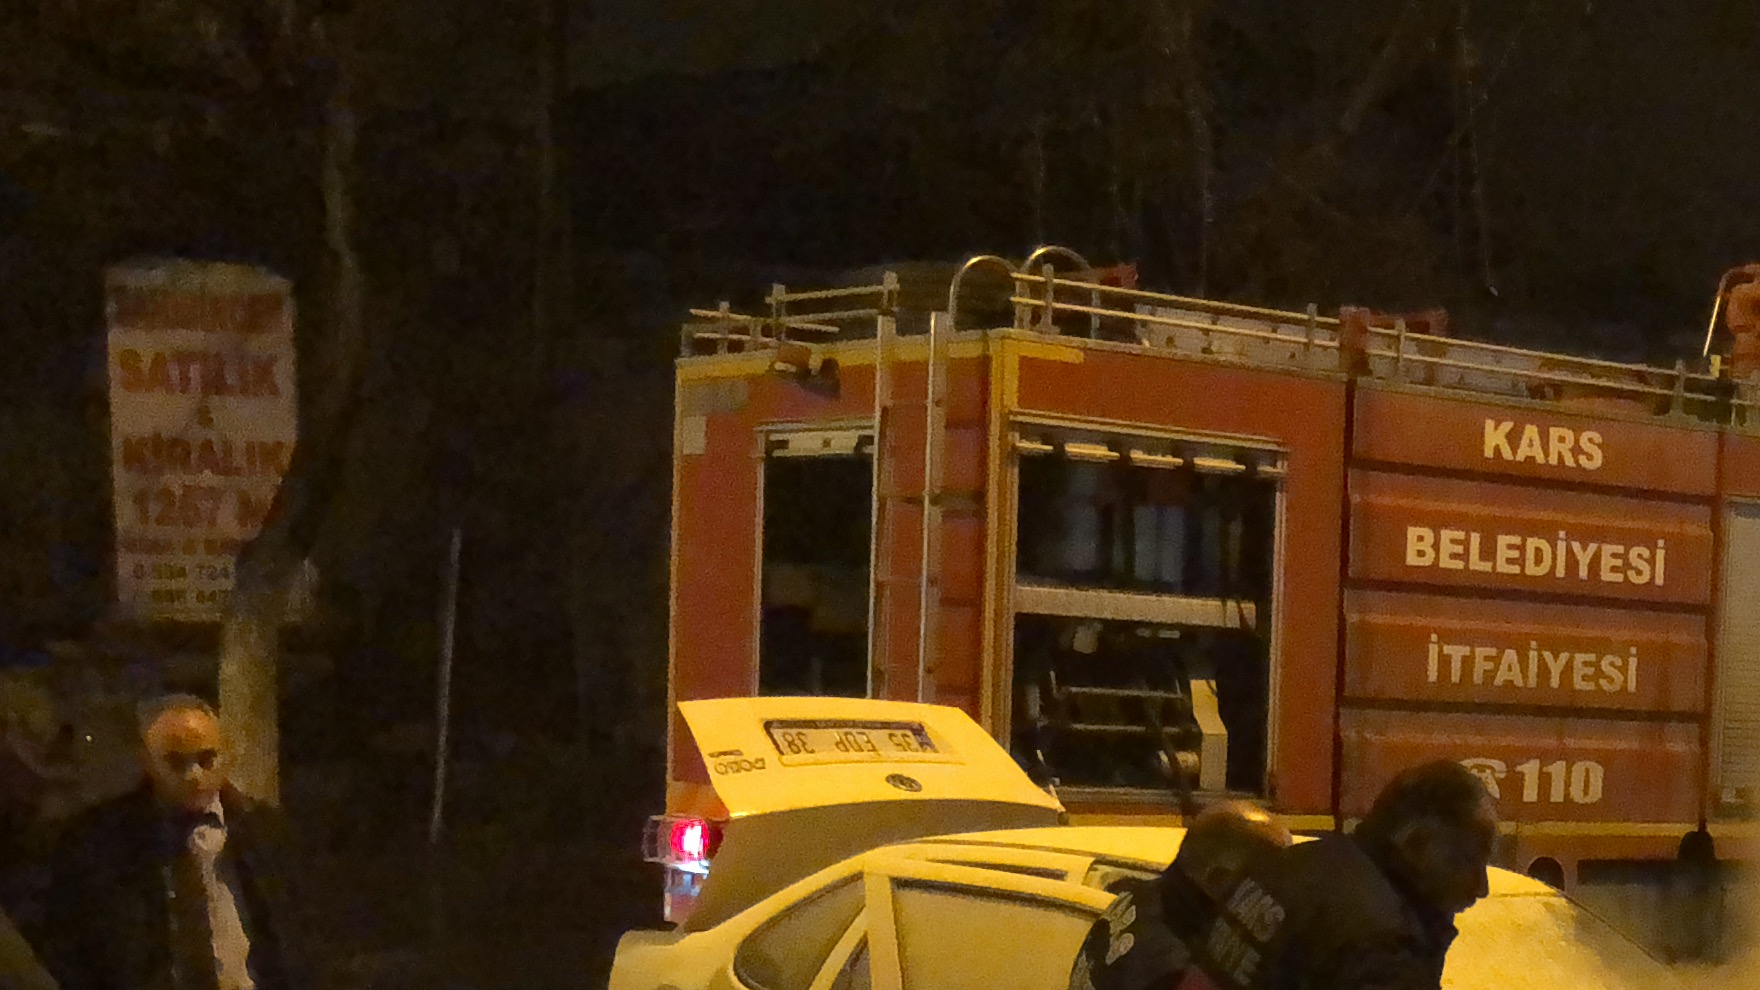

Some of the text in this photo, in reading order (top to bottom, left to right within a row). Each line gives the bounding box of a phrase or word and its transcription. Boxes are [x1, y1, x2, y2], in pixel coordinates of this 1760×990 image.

[118, 348, 281, 398] SATILIK
[1483, 418, 1604, 471] KARS
[1404, 525, 1667, 587] BELEDİYESİ
[1426, 632, 1639, 694] İTFAİYESİ
[784, 731, 815, 755] 38
[833, 730, 878, 753] EDP
[1515, 757, 1605, 804] 110
